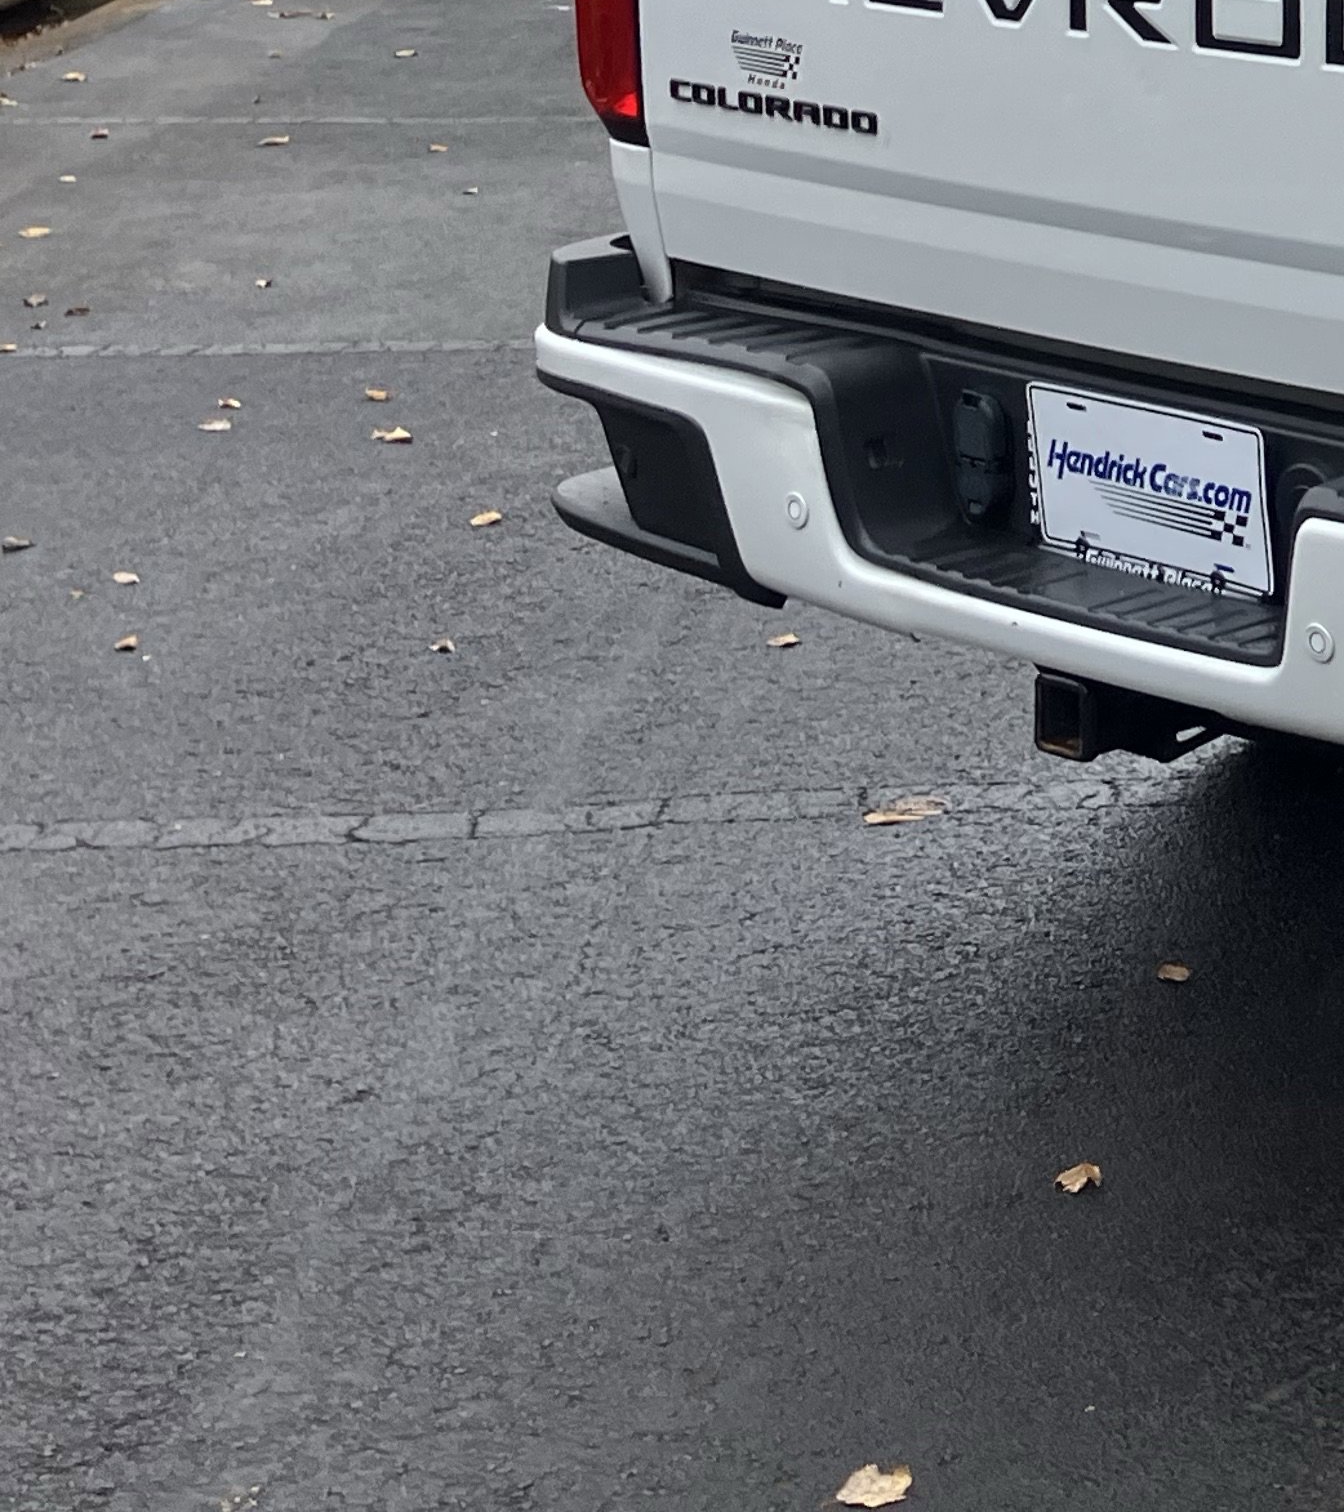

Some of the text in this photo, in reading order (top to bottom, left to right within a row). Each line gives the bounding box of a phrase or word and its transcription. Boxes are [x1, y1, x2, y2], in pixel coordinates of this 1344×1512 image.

[730, 29, 804, 56] Gwinnett Place
[747, 73, 787, 90] Honda
[669, 77, 878, 136] COLORADO
